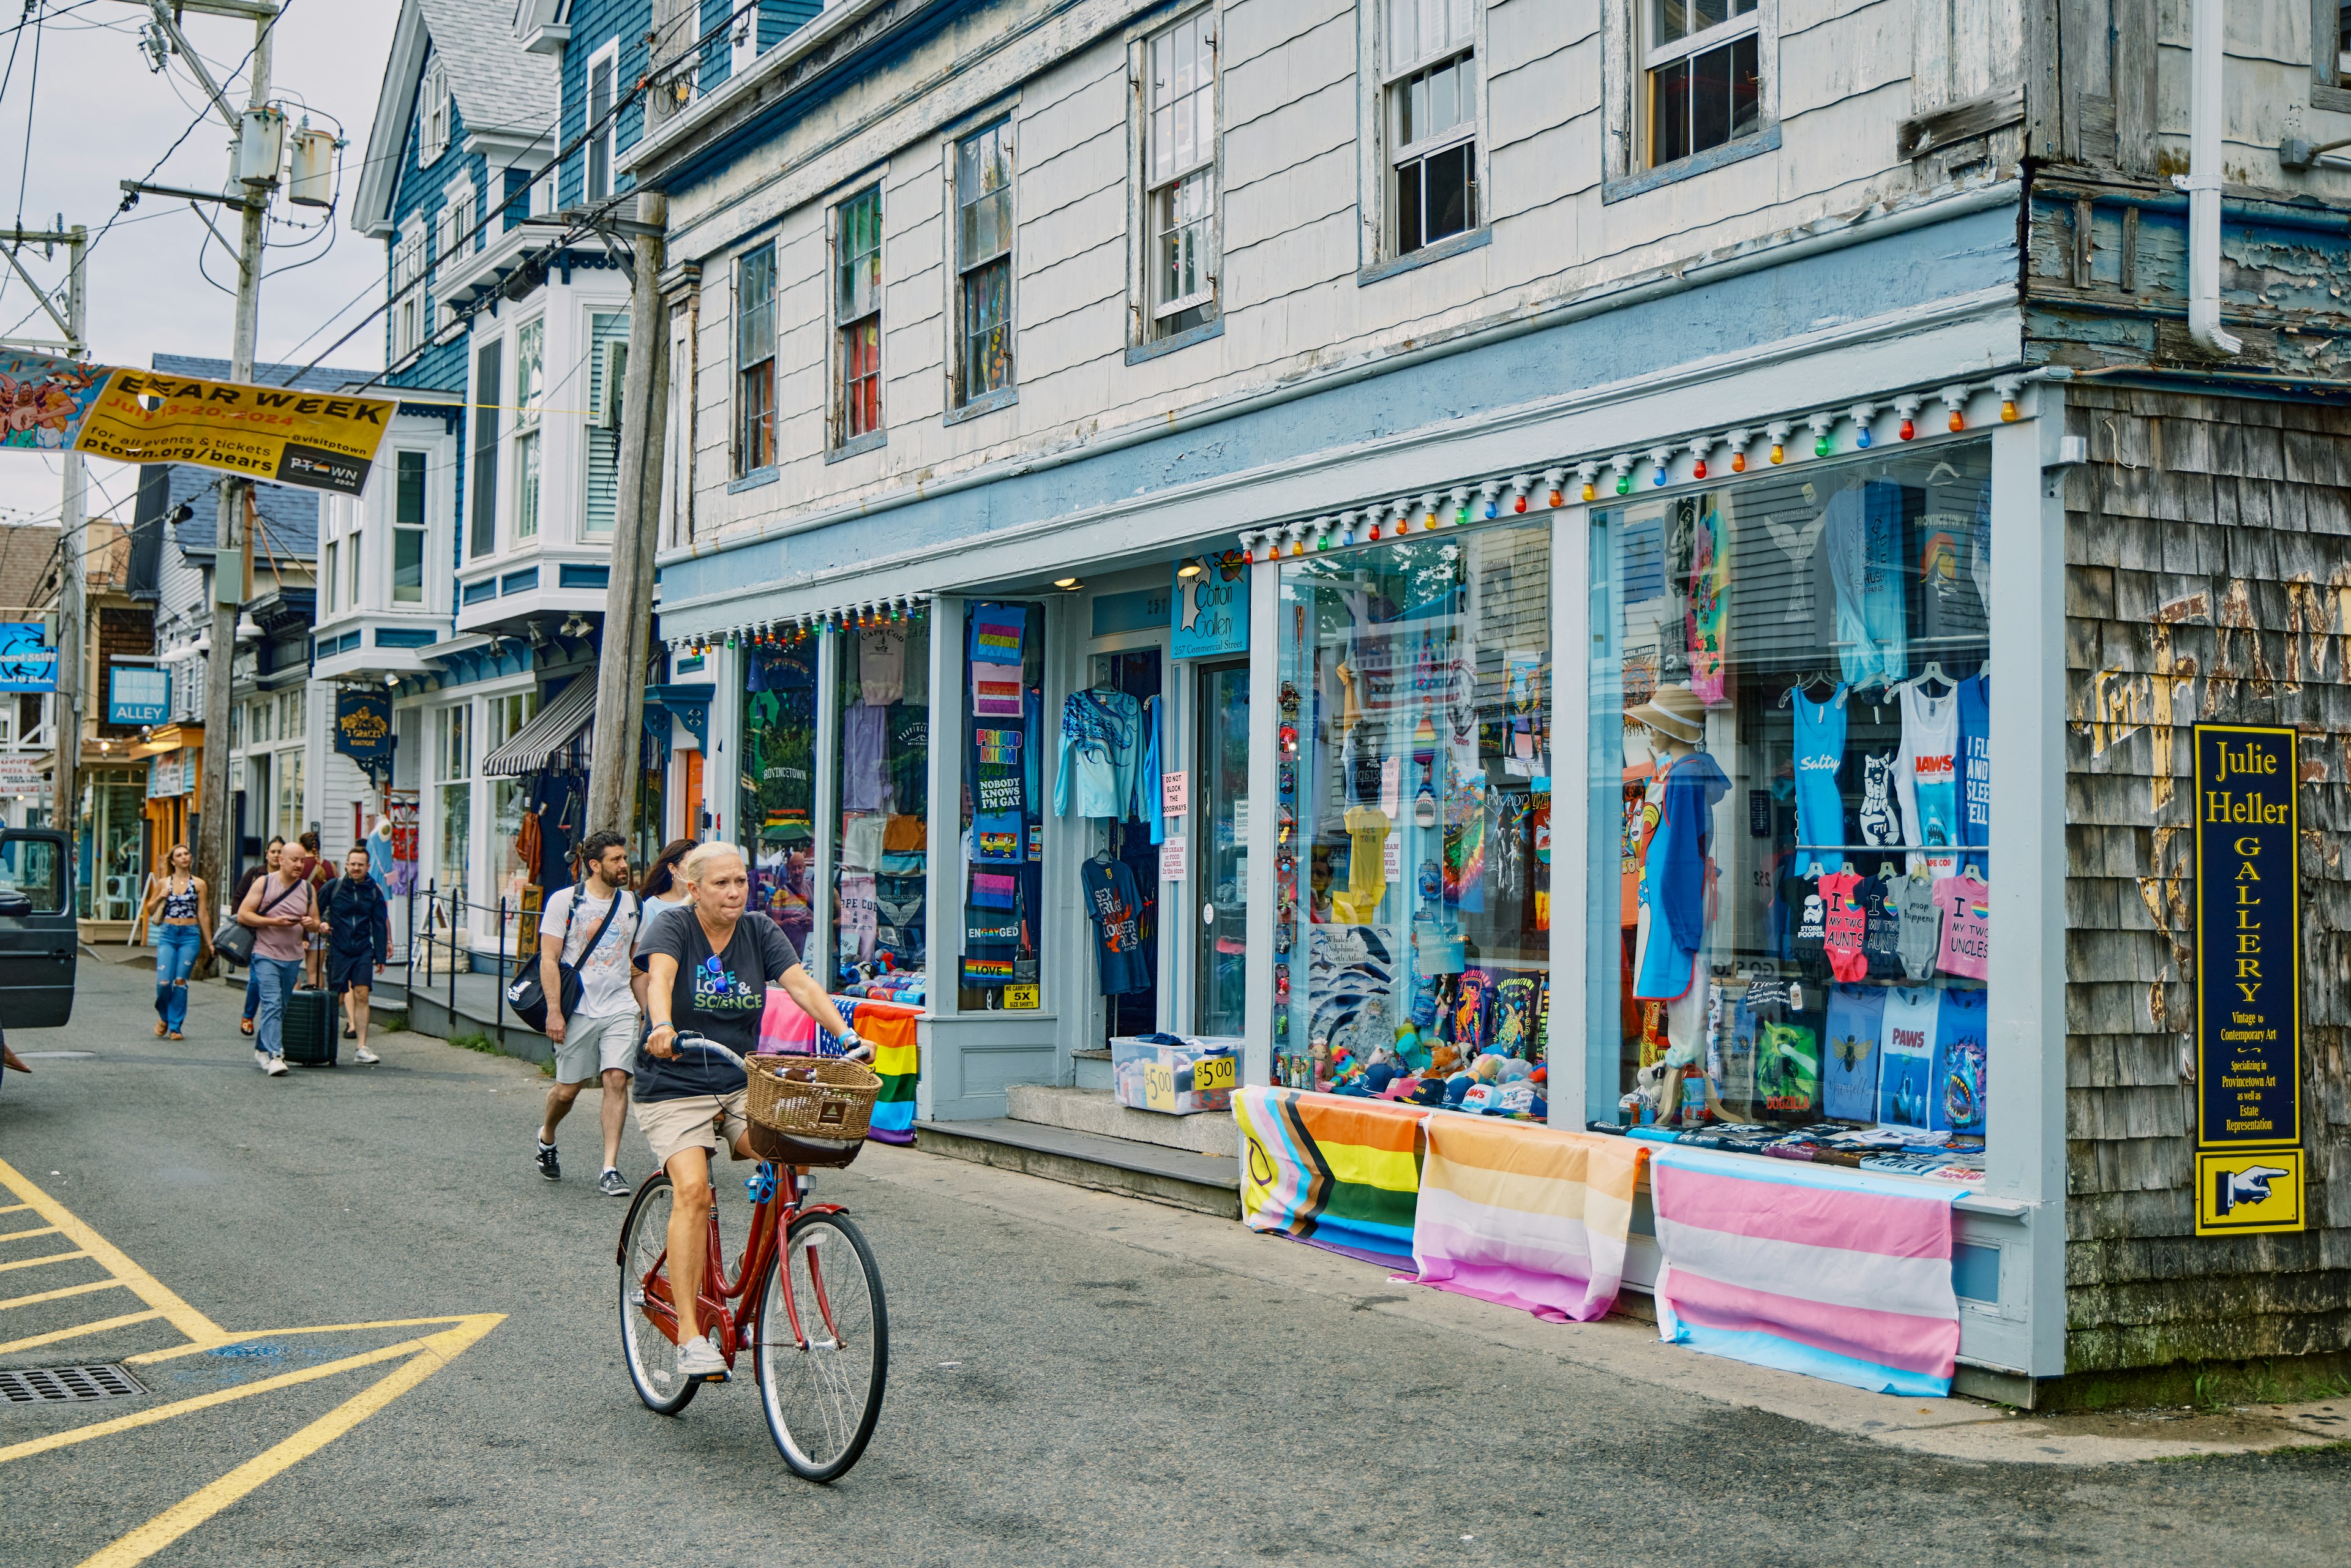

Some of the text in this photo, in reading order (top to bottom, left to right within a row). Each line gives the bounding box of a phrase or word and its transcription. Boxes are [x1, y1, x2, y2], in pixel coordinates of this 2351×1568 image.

[106, 398, 156, 422] July
[233, 411, 294, 426] 2024
[256, 392, 392, 425] WEEK
[91, 426, 271, 456] for all events & tickets
[291, 433, 367, 456] @visitptown
[83, 438, 273, 471] ptown.org/bears
[1771, 506, 1824, 519] PROVINCETOWN
[1914, 514, 1968, 528] PROVINCETOWN
[1194, 582, 1232, 609] Cotton
[1147, 599, 1167, 614] 257
[1194, 611, 1233, 640] Gallery
[861, 629, 904, 642] CAPE COD
[1174, 640, 1242, 655] 257 Commercial Street
[116, 706, 163, 719] ALLEY
[346, 729, 381, 738] 3 GRACES
[976, 729, 1022, 748] PROUD
[1967, 736, 1972, 756] I
[980, 746, 1018, 765] MOM
[1916, 754, 1954, 772] JAWS
[2215, 741, 2277, 782] Julie
[1799, 754, 1840, 773] Salty
[1967, 758, 1989, 781] AND
[762, 767, 807, 781] ROVINCETOWN
[980, 778, 1020, 790] NOBODY
[981, 787, 1020, 799] KNOWS
[981, 795, 1021, 809] I'M GAY
[1163, 804, 1187, 813] DOORWAYS
[2206, 791, 2289, 824] Heller
[1095, 888, 1113, 903] SEX
[1830, 891, 1841, 913] I
[1868, 895, 1880, 916] I
[1910, 902, 1929, 912] poop
[1953, 896, 1965, 918] I
[1828, 916, 1863, 929] MY TWO
[1904, 909, 1934, 923] happens
[2233, 836, 2262, 1002] GALLERY
[1869, 918, 1881, 930] MY
[1952, 922, 1965, 932] MY
[968, 926, 1019, 938] ENGAYGED
[1826, 930, 1863, 948] AUNTS
[1326, 943, 1354, 954] Dolphins
[1951, 937, 1988, 959] UNCLES
[975, 966, 1002, 976] LOVE
[1458, 969, 1492, 988] PROVINCETOWN
[738, 981, 752, 995] &
[1497, 978, 1535, 992] PROVINCETOWN
[694, 993, 762, 1009] SCIENCE
[1014, 992, 1030, 1000] 5X
[1772, 996, 1791, 1004] together
[2232, 1011, 2263, 1026] Vintage to
[1892, 1027, 1924, 1048] PAWS
[2221, 1028, 2276, 1043] Contemporary Art
[2231, 1060, 2267, 1073] Specializing in
[2222, 1076, 2276, 1089] Provincetown Art
[1766, 1095, 1810, 1110] DOGZILLA
[2244, 1090, 2254, 1100] well
[2255, 1091, 2261, 1100] as
[2240, 1105, 2258, 1117] Estate
[2226, 1118, 2272, 1133] Representation
